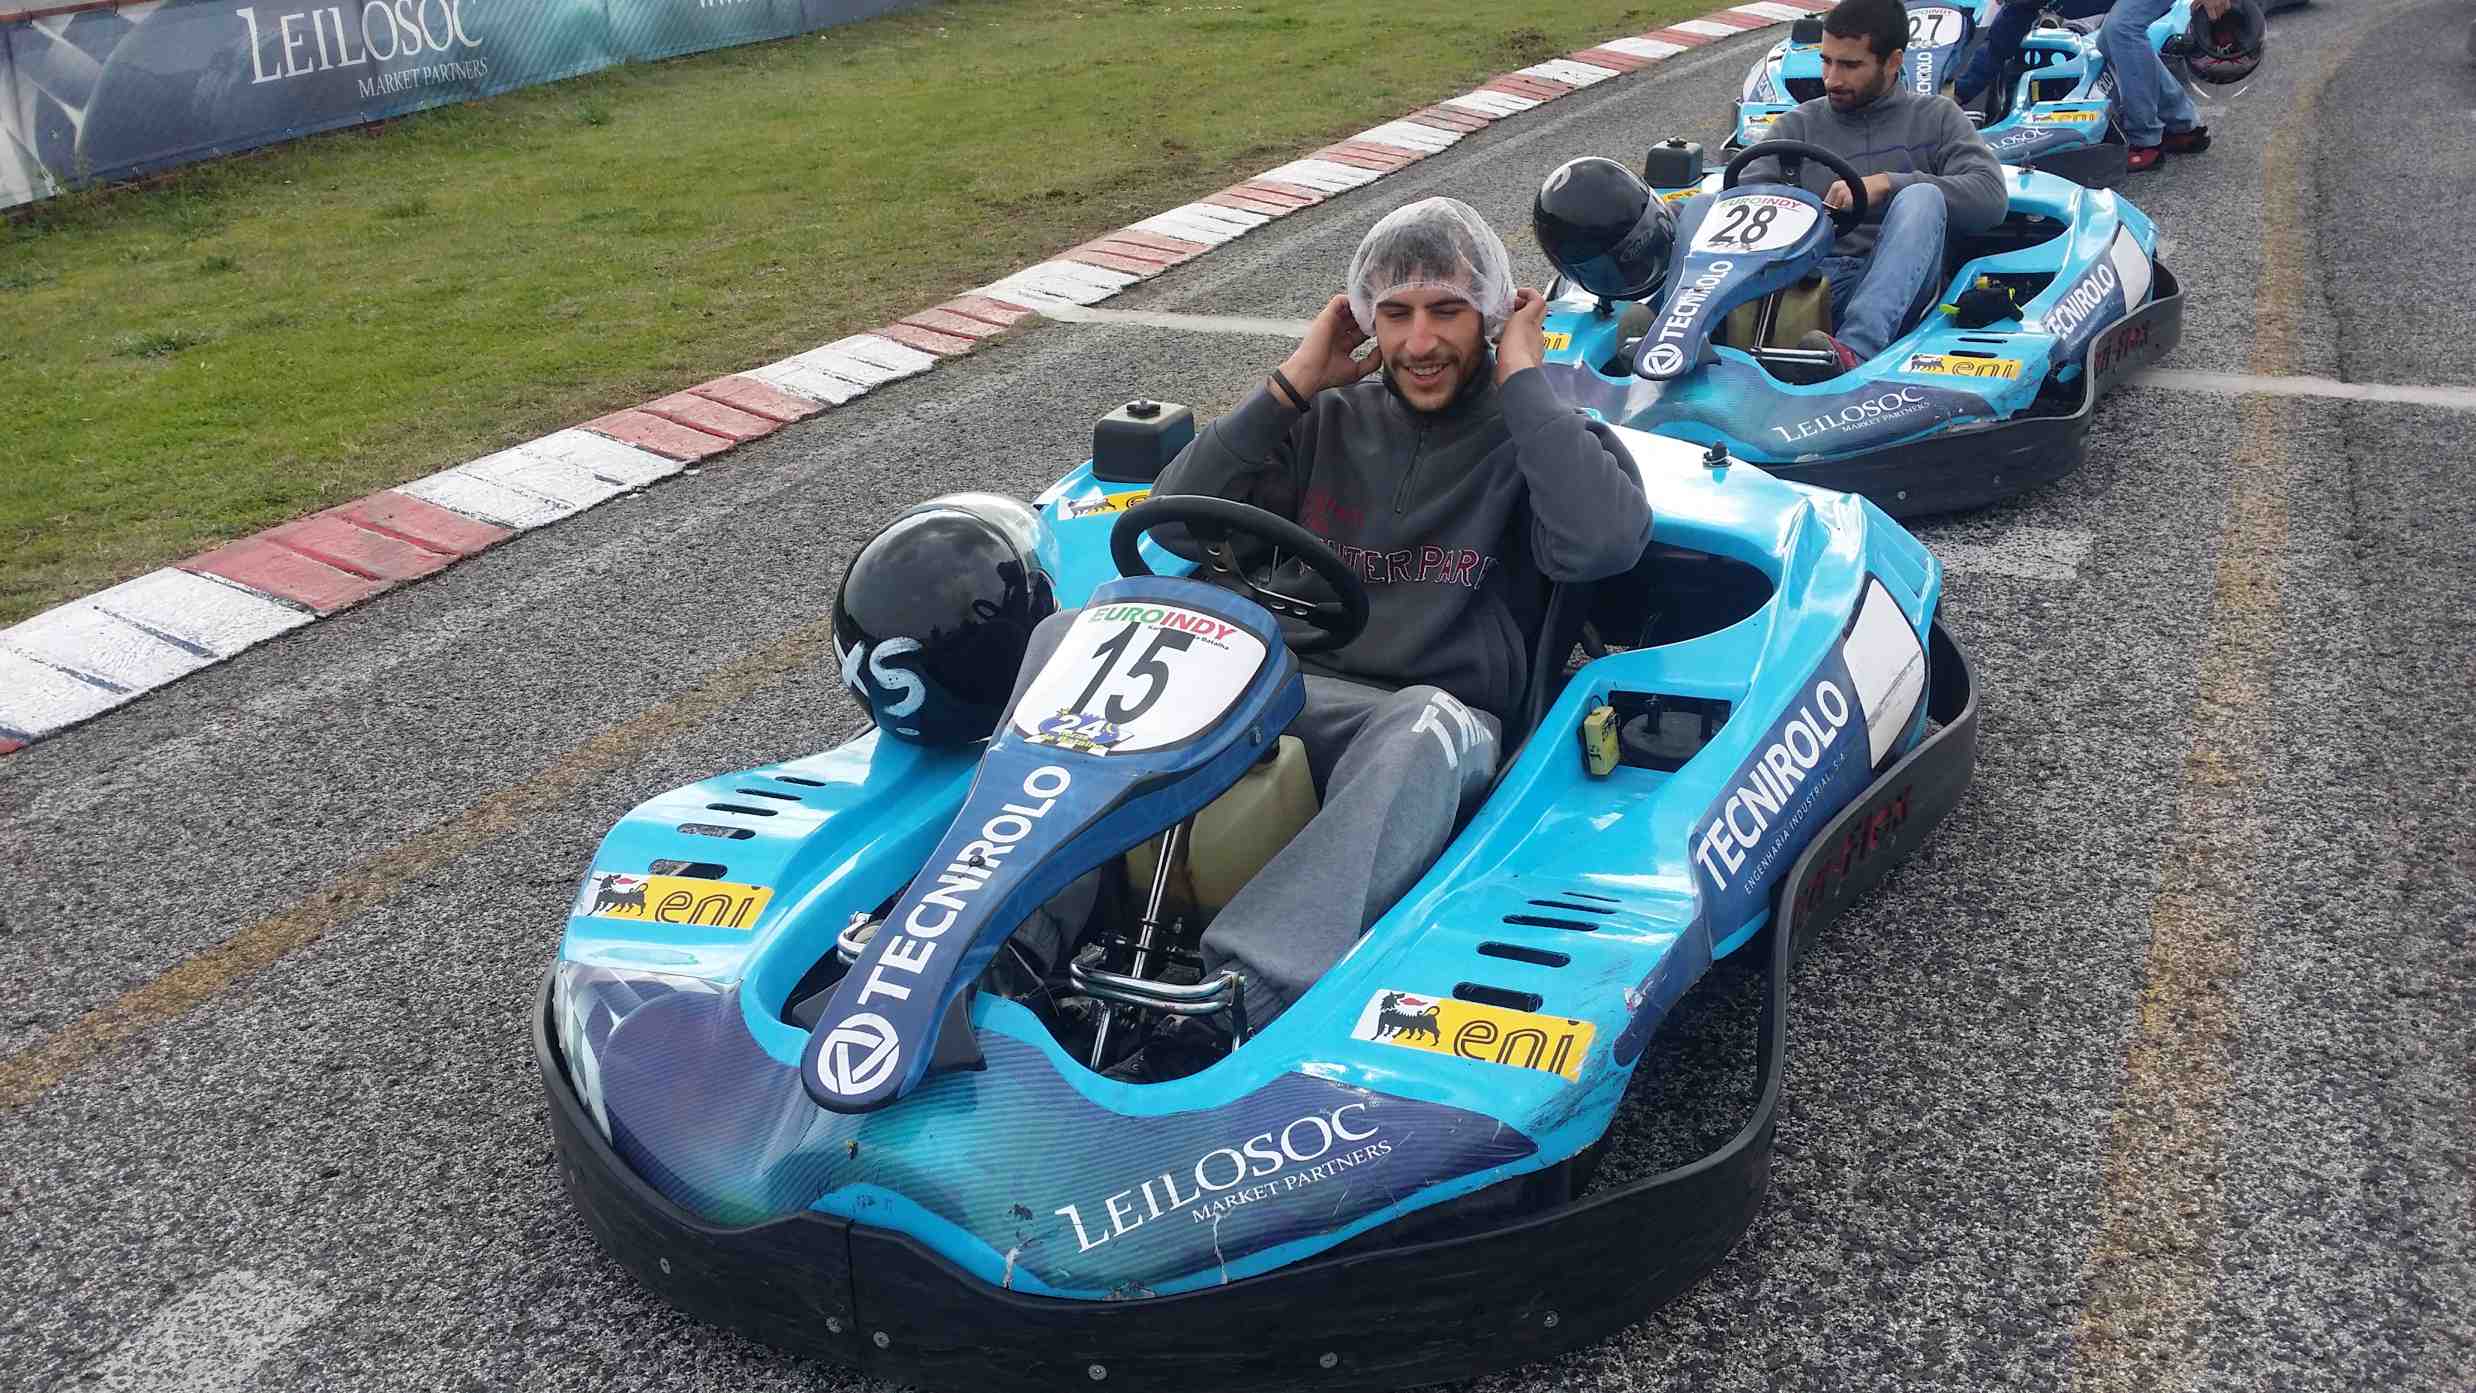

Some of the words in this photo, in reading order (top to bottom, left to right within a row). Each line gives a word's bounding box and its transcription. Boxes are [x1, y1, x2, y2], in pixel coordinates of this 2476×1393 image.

[236, 0, 482, 84] LEILOSOC
[1908, 14, 1943, 41] 27
[358, 68, 420, 98] MARKET
[423, 57, 489, 83] PARTNERS
[1708, 204, 1778, 244] 28
[1951, 359, 2017, 378] eni
[1772, 386, 1924, 443] LEILOSOC
[1842, 417, 1881, 433] MARKET
[1883, 401, 1931, 422] PARTNERS
[1089, 606, 1236, 642] EUROINDY
[1070, 621, 1196, 725] 15
[1697, 680, 1849, 892] TECNIROLO
[859, 766, 1072, 1005] TECNIROLO
[1744, 829, 1790, 896] ENGENHARIA
[654, 885, 762, 929] eni
[1452, 1018, 1581, 1077] eni
[1055, 1102, 1380, 1254] LEILOSOC
[1192, 1179, 1280, 1226] MARKET
[1283, 1139, 1393, 1194] PARTNERS
